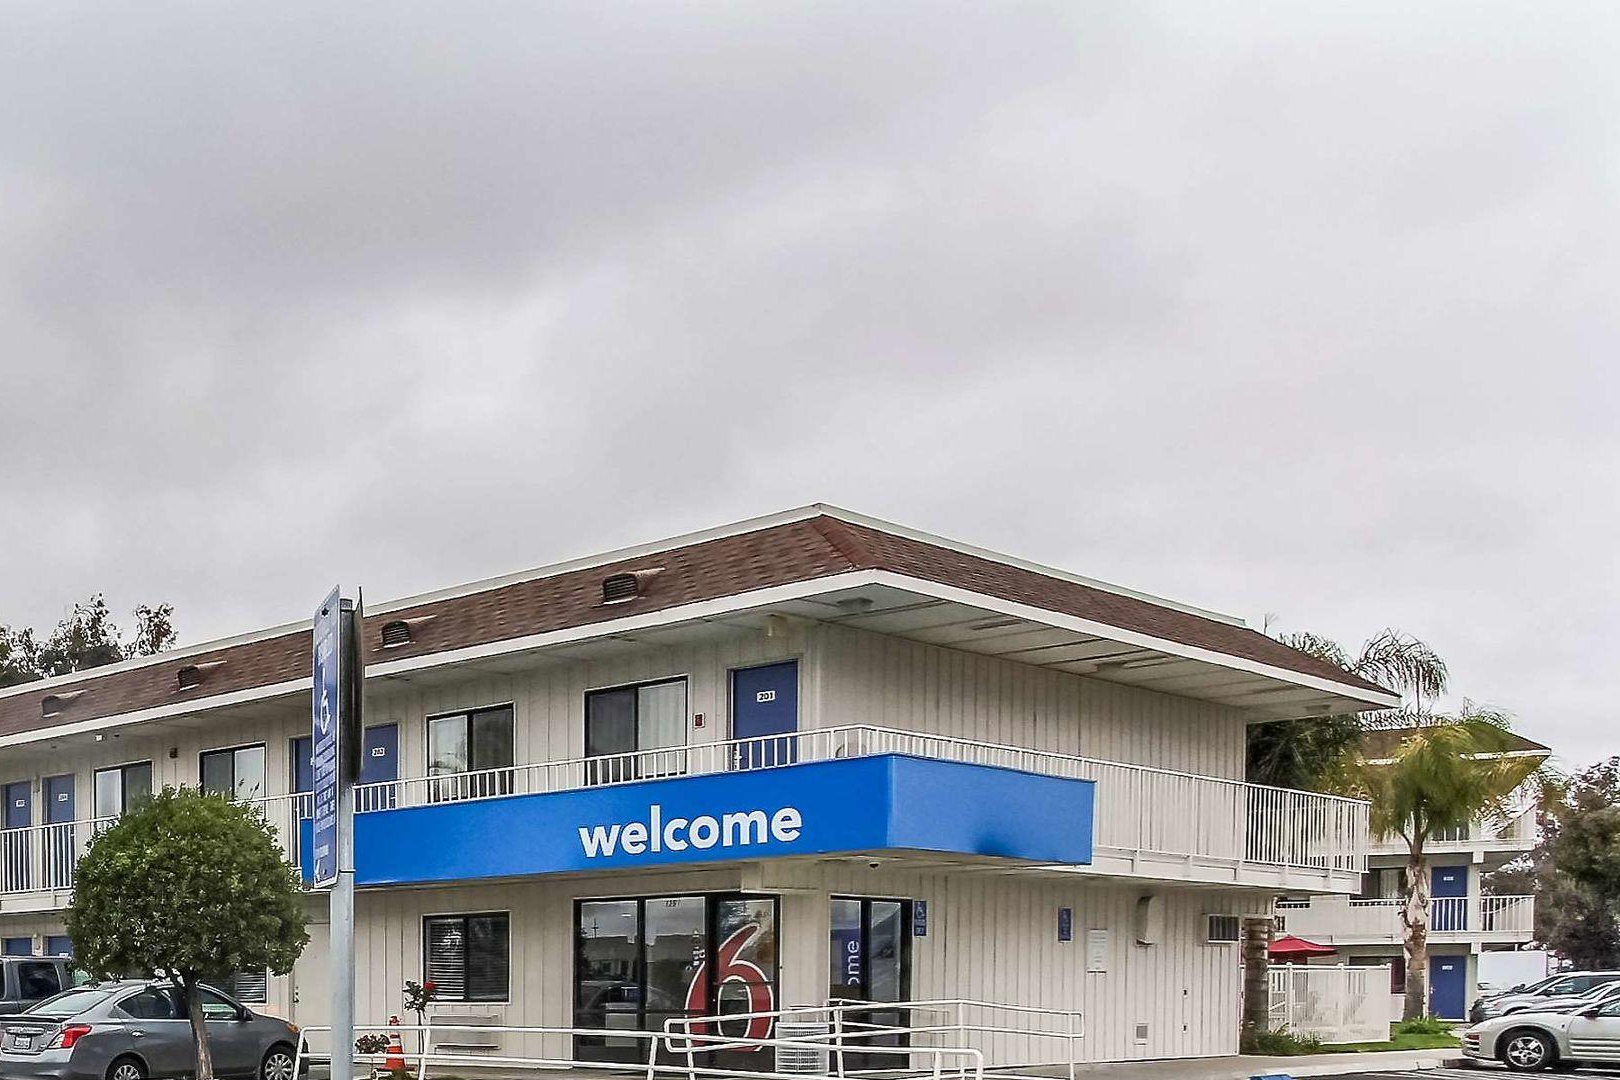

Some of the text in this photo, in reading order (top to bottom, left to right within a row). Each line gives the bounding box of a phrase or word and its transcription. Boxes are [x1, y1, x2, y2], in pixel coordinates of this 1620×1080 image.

[758, 691, 774, 701] 201
[578, 804, 803, 858] welcome
[684, 921, 774, 1052] 6
